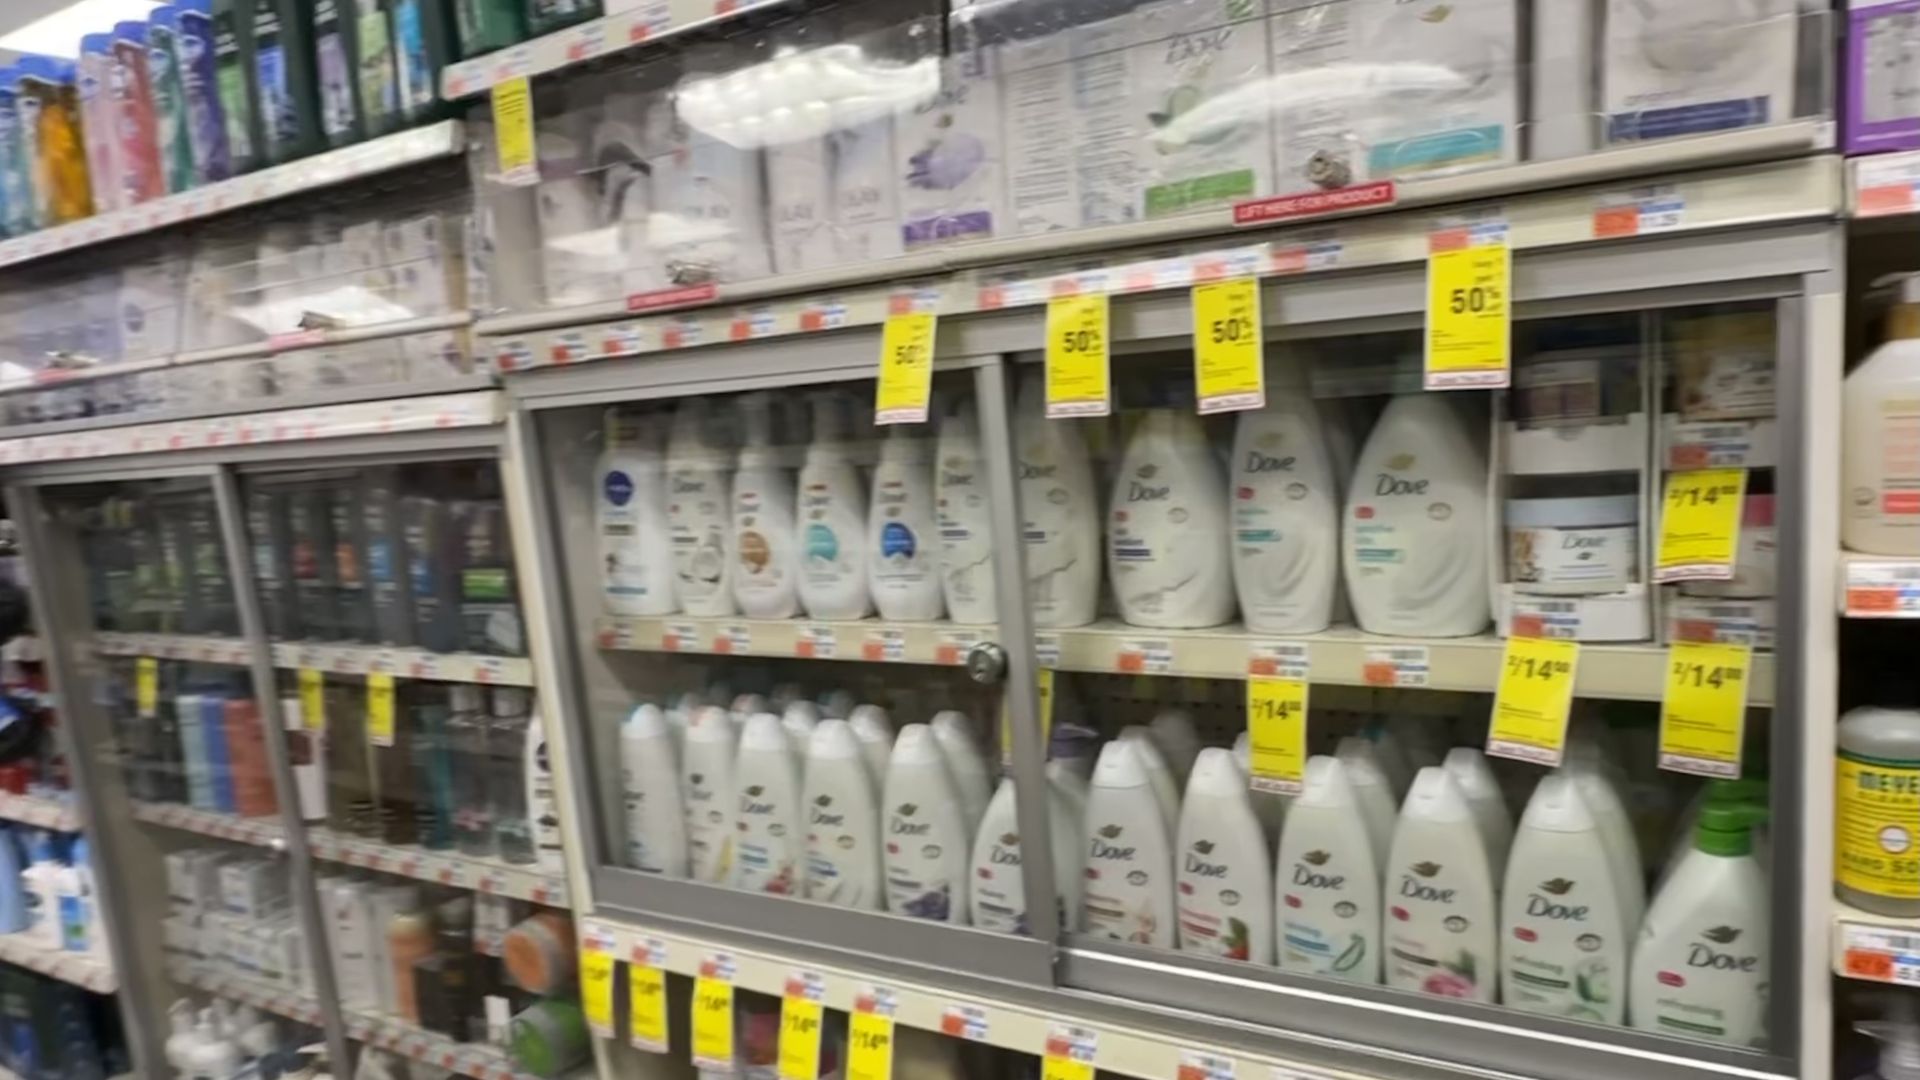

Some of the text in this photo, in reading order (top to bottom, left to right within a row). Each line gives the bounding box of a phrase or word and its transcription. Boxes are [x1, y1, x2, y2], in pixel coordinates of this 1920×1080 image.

[1326, 186, 1389, 209] PRODUCT
[1244, 451, 1297, 474] Dove
[1127, 481, 1170, 502] Dove
[1375, 473, 1430, 497] Dove
[891, 815, 932, 836] Dove
[990, 844, 1021, 866] Dov
[1090, 838, 1137, 860] Dove
[1185, 852, 1229, 879] Dove
[1292, 863, 1346, 891] Dove
[1400, 874, 1457, 903] Dove
[1526, 893, 1591, 922] Dove
[1687, 942, 1760, 973] Dove
